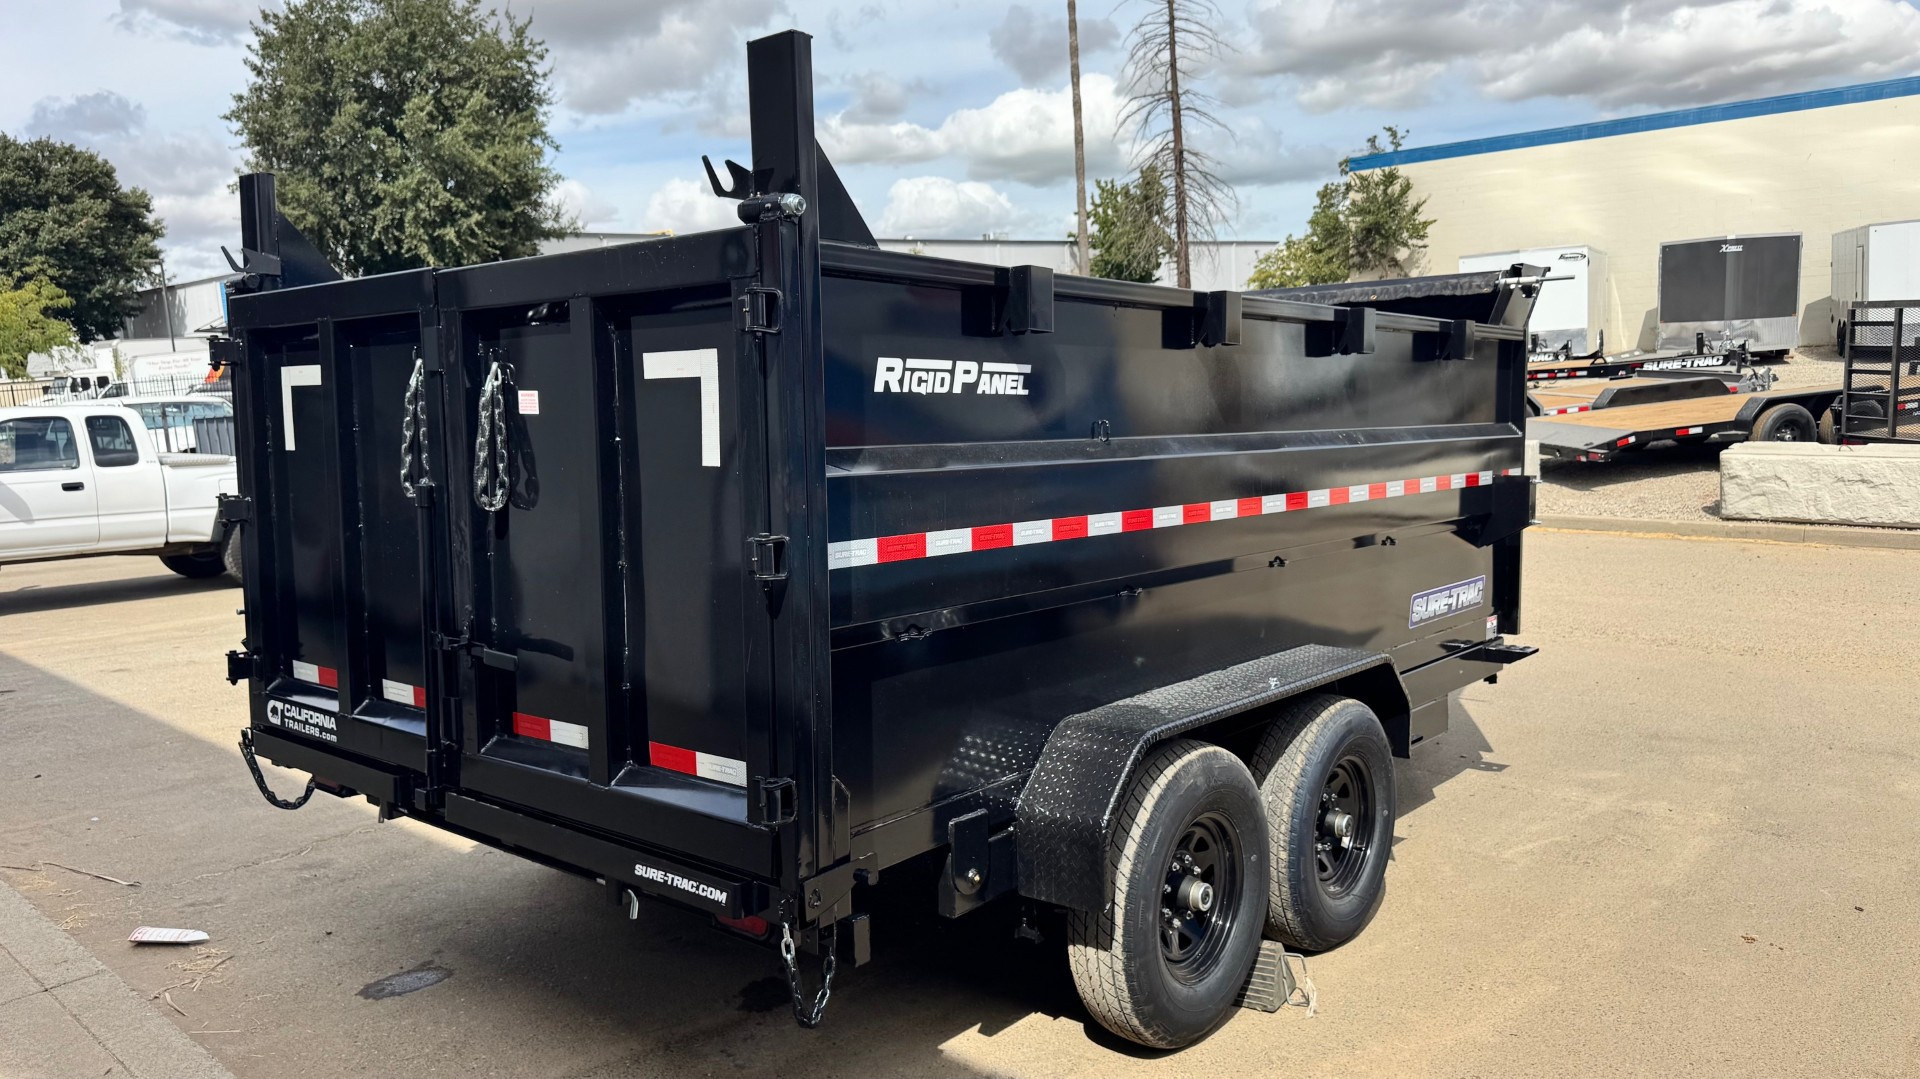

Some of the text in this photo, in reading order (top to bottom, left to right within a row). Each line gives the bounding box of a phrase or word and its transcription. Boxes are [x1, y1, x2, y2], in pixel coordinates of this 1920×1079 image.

[1643, 355, 1724, 371] SURE-TRAC
[1411, 580, 1483, 623] SURE-TRAC
[284, 703, 337, 731] CALIFORNIA
[284, 718, 338, 743] TRAILERS.com
